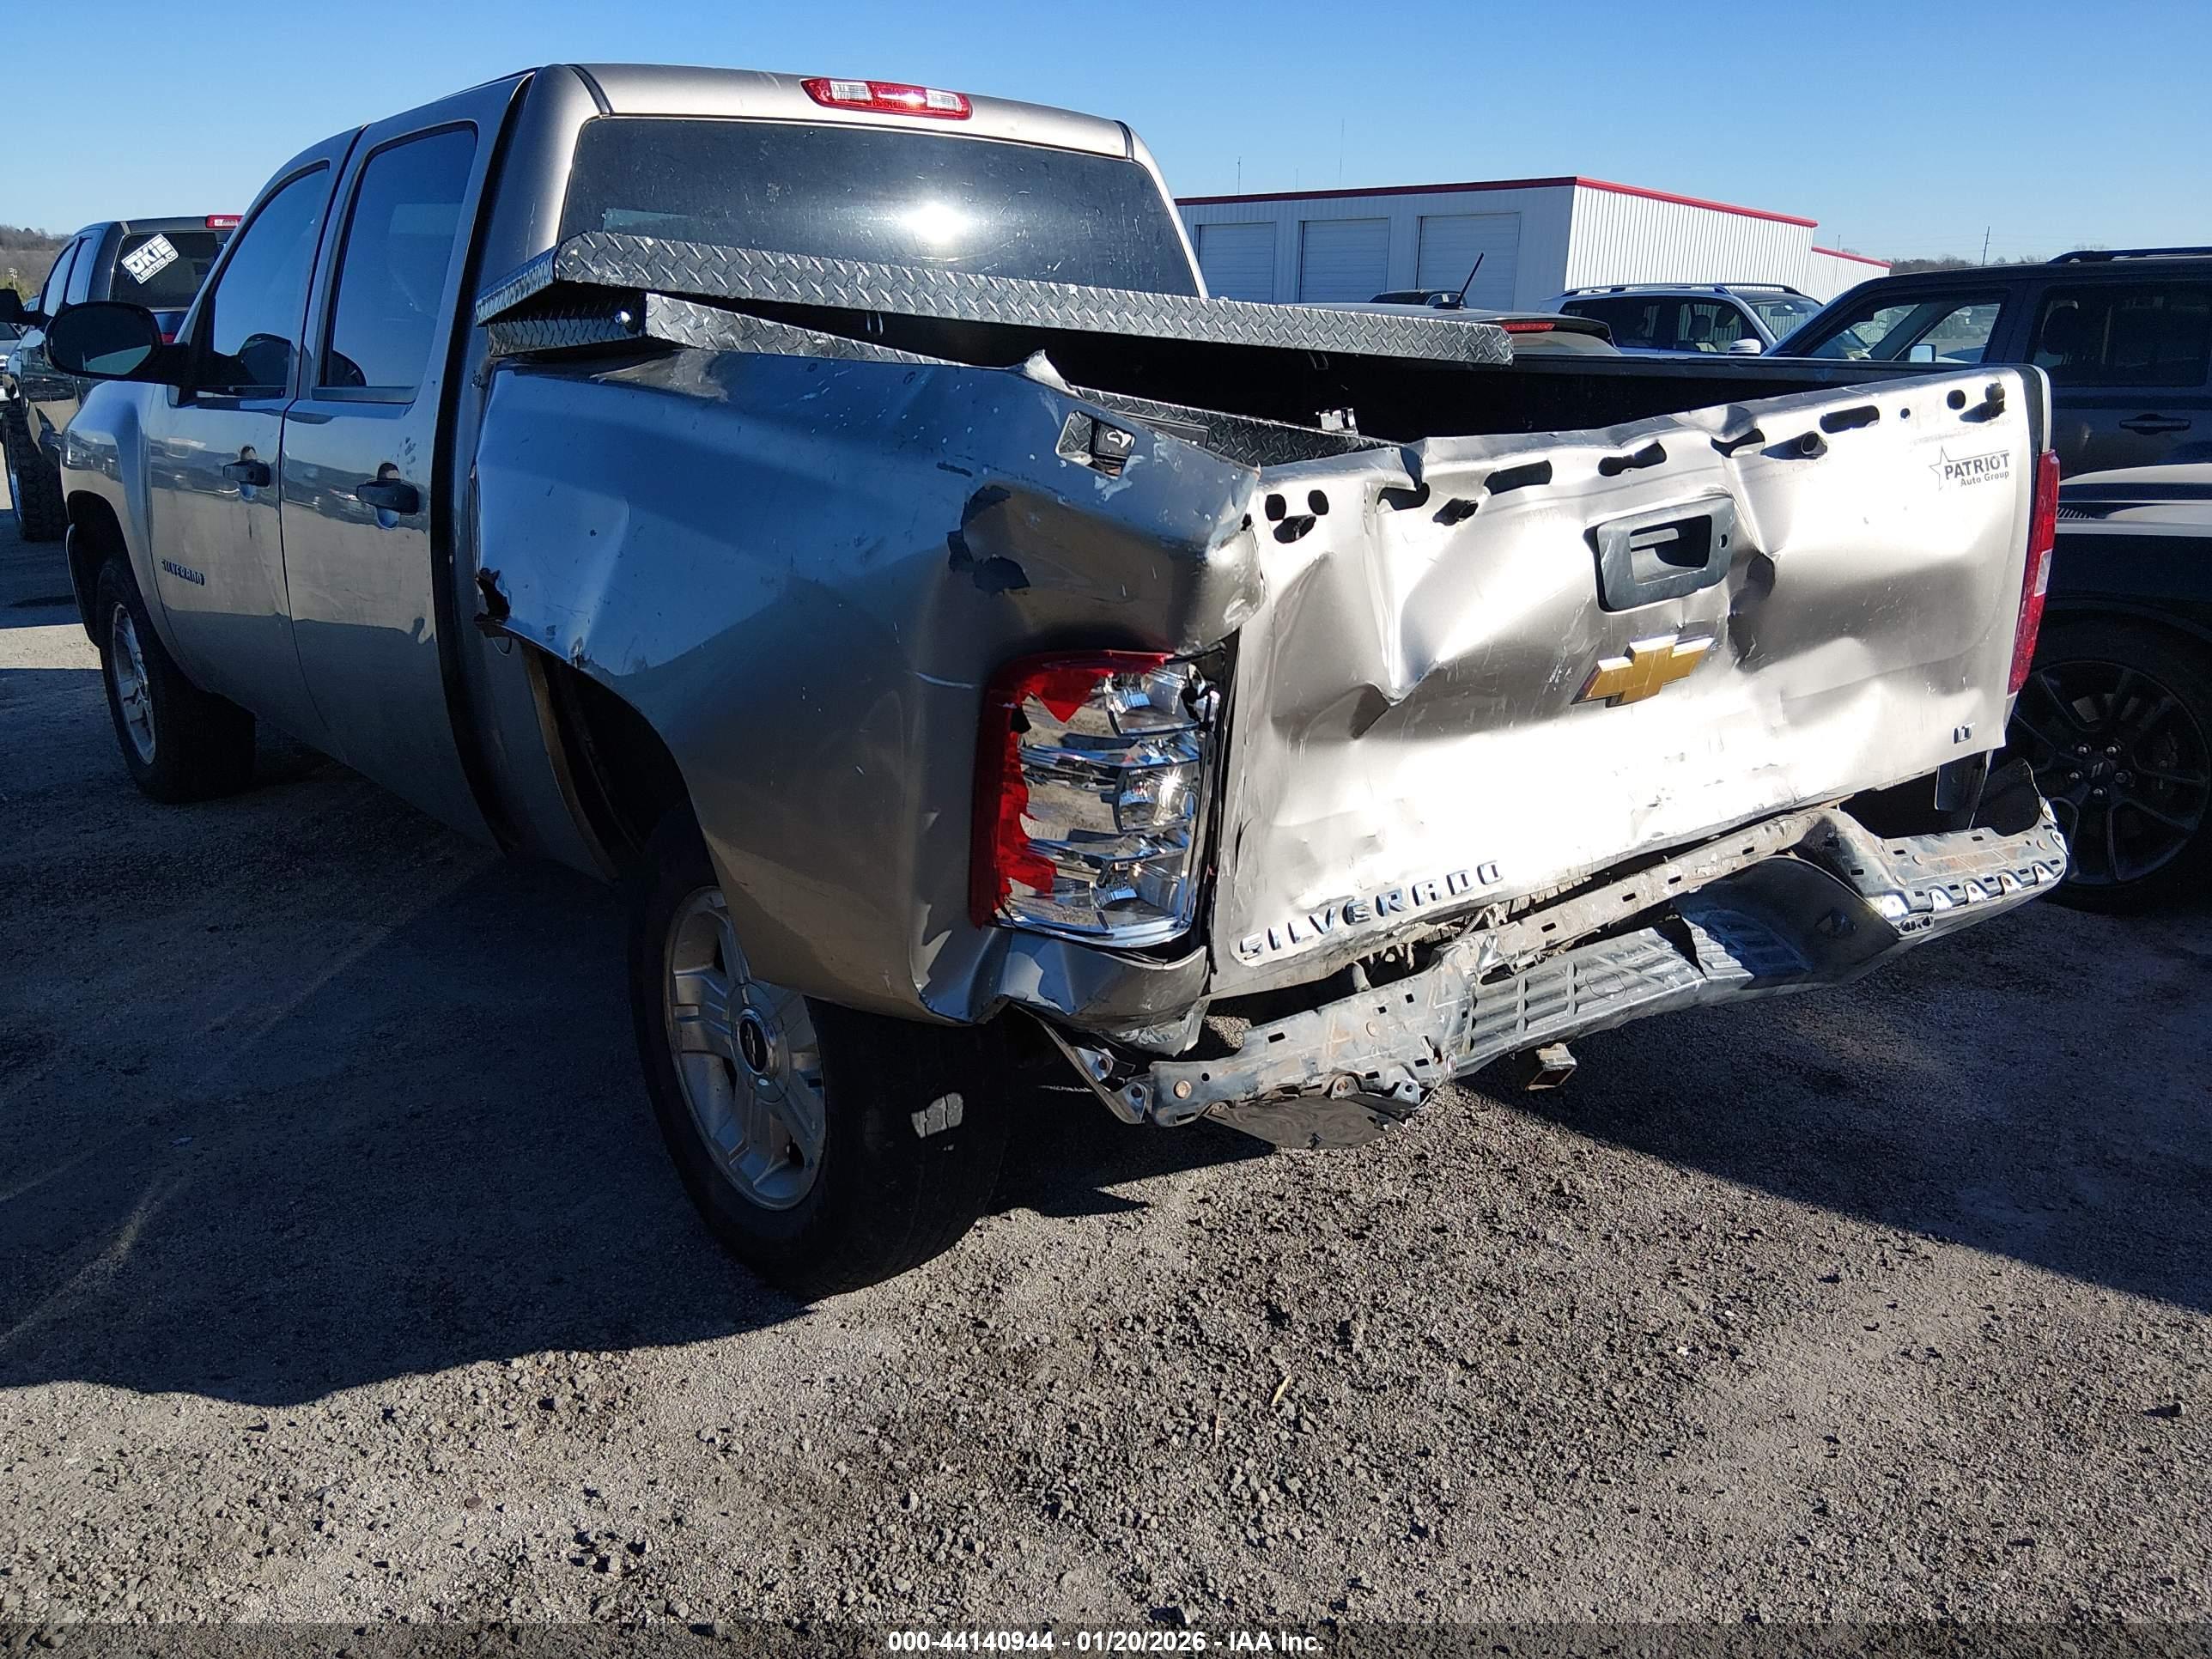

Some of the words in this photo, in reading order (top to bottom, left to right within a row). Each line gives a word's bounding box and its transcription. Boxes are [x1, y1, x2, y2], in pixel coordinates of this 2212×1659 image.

[123, 236, 173, 274] OKIE
[1944, 453, 2010, 481] PATRIOT
[1960, 477, 1983, 488] Auto
[1984, 470, 2010, 483] Group
[1953, 722, 1975, 744] LT
[1238, 860, 1505, 961] SILVERADO
